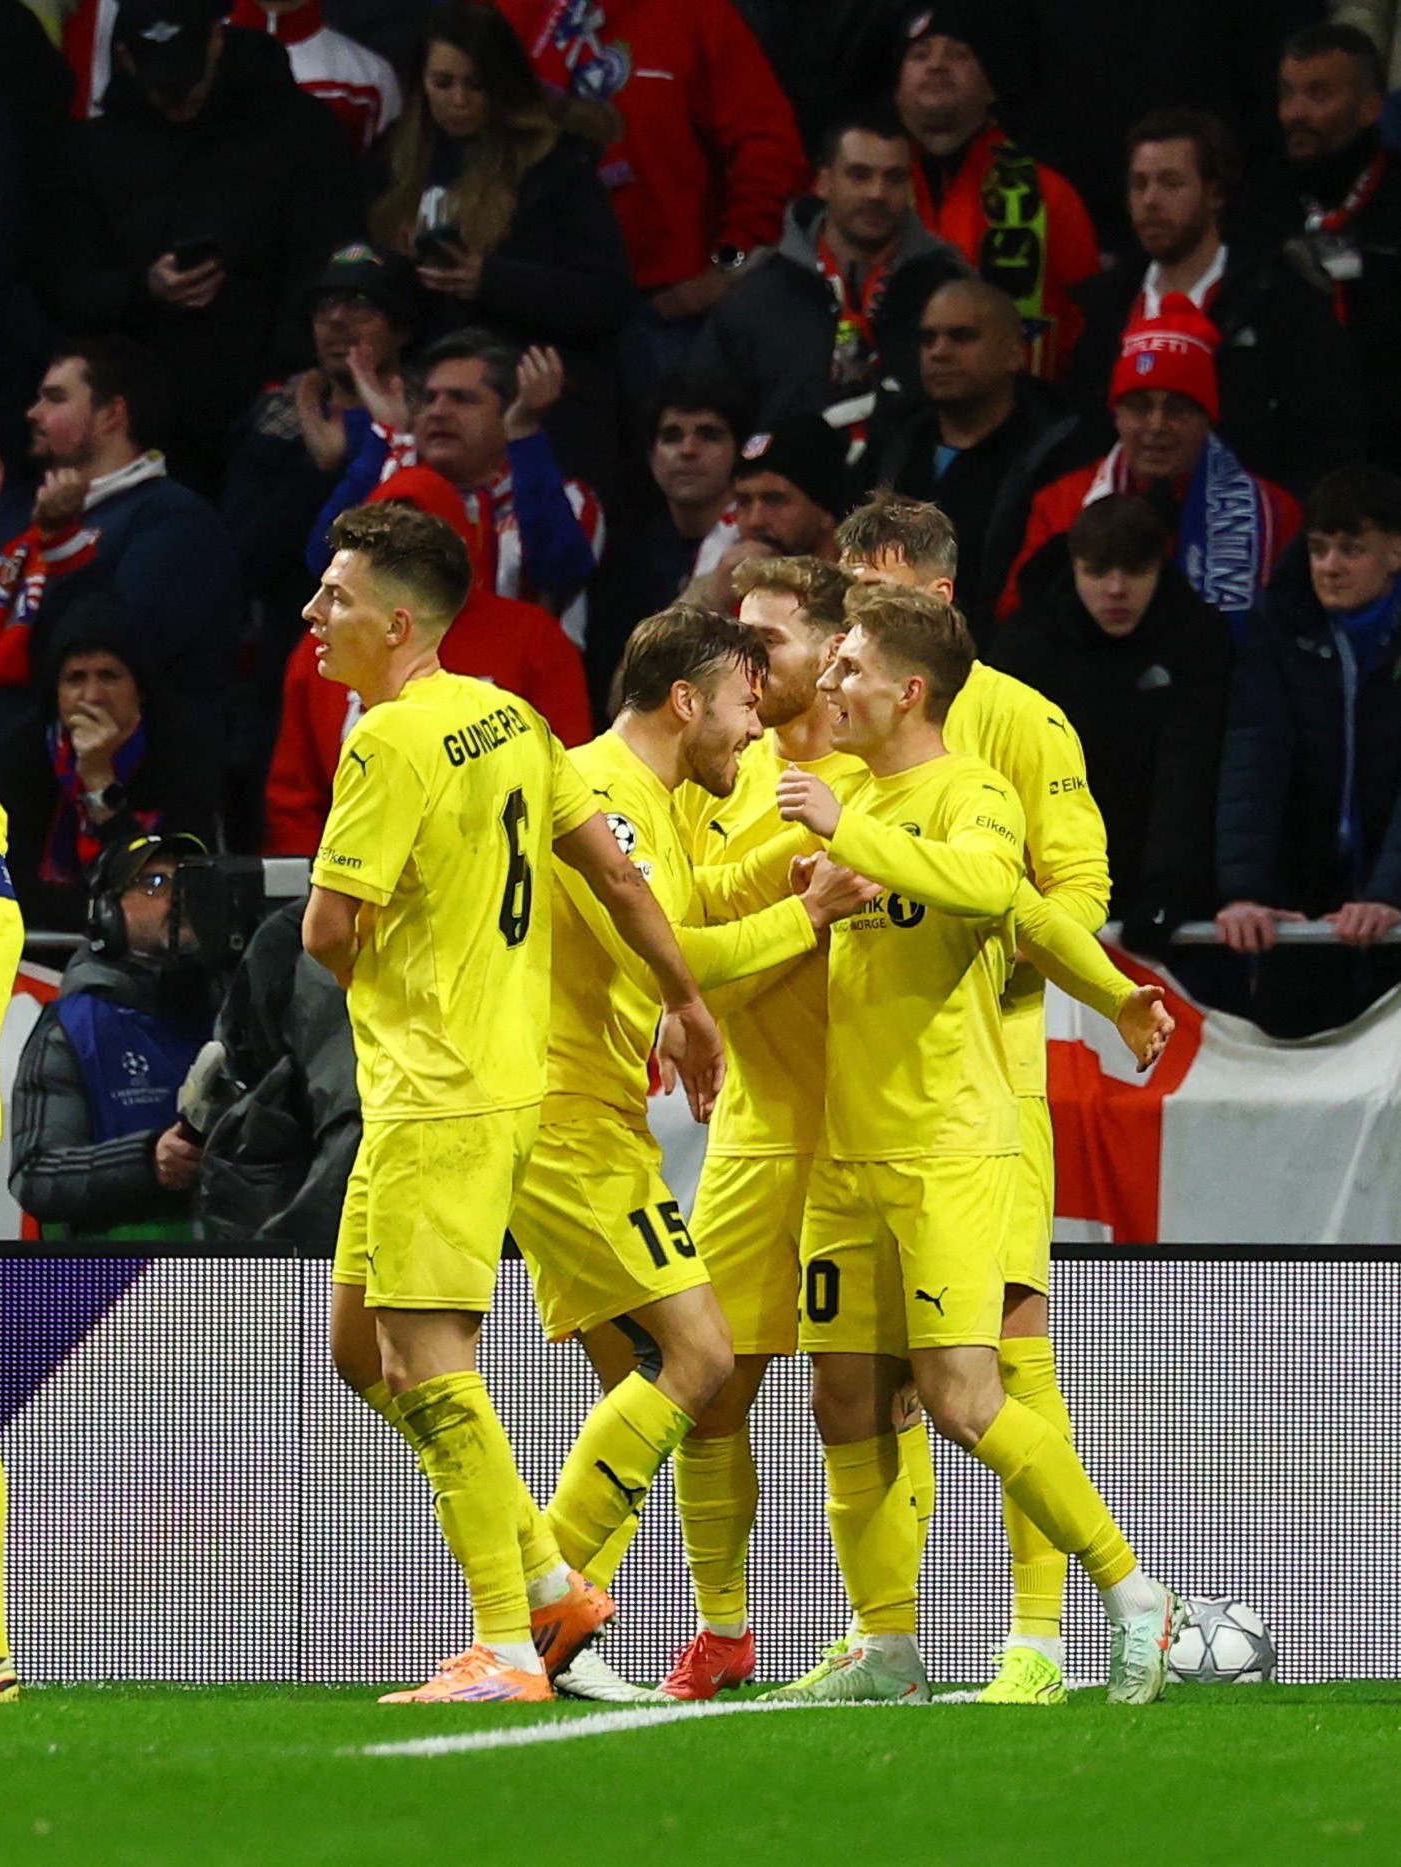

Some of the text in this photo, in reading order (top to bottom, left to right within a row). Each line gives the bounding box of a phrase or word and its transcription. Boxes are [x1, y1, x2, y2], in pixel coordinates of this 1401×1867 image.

[1062, 776, 1088, 793] Elk
[975, 815, 1018, 846] Elkem
[497, 784, 533, 950] 6
[851, 917, 887, 931] NORGE
[627, 1200, 697, 1270] 15
[798, 1259, 841, 1323] 0
